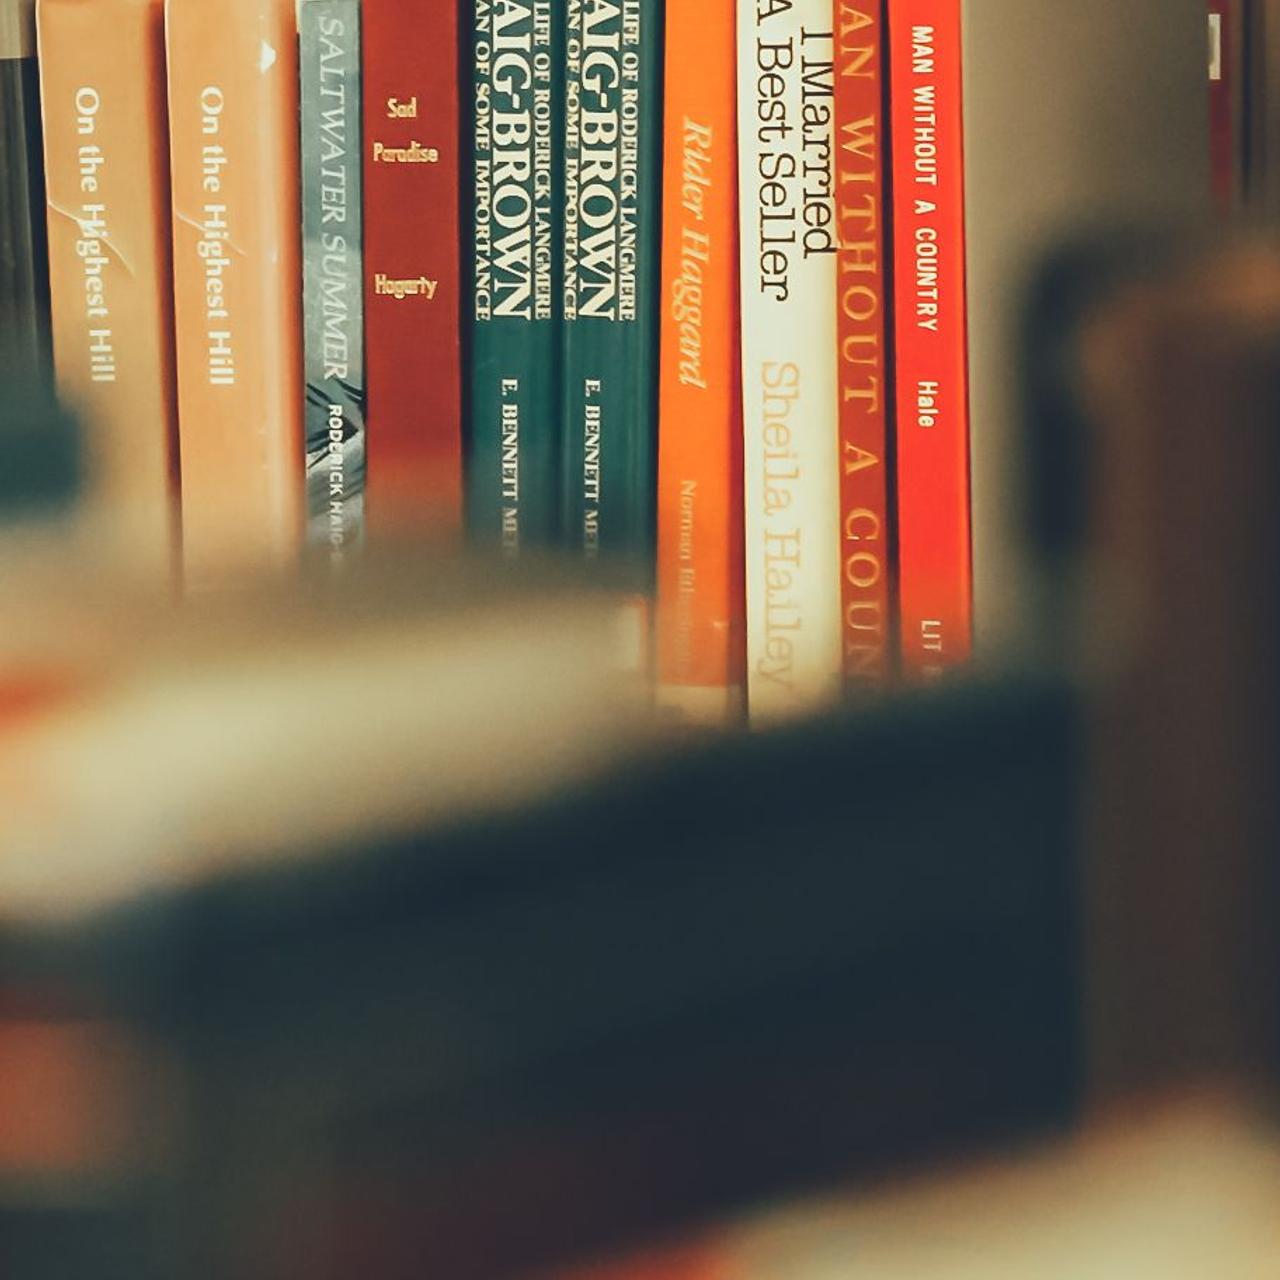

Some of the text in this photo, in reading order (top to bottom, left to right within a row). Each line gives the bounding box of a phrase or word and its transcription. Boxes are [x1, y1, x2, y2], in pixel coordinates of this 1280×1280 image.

[475, 42, 491, 76] OF
[534, 2, 550, 46] LIFE
[534, 52, 551, 82] OF
[567, 38, 581, 75] OF
[621, 52, 640, 83] OF
[623, 1, 641, 45] LIFE
[387, 96, 417, 119] Sad
[475, 82, 491, 151] SOME
[566, 80, 580, 151] SOME
[757, 37, 793, 143] Best
[373, 141, 439, 163] Paradise
[534, 88, 551, 203] RODERICK
[621, 88, 639, 203] RODERICK
[800, 26, 841, 260] I Married
[912, 25, 938, 332] MAN WITHOUT A COUNTRY
[75, 86, 116, 382] On the Highest Hill
[196, 86, 235, 385] On the Highest Hill
[318, 16, 349, 380] SALTWATER SUMMER
[475, 158, 491, 322] IMPORTANCE
[564, 158, 579, 321] IMPORTANCE
[758, 152, 796, 302] Seller
[535, 207, 551, 320] LANGMERE
[619, 206, 637, 321] LANGMERE
[672, 116, 713, 390] Rider Haggard
[841, 116, 880, 415] WITHOUT
[501, 378, 519, 396] E.
[584, 378, 601, 397] E.
[917, 380, 939, 428] Hale
[327, 403, 345, 496] RODERICK
[502, 404, 519, 502] BENNETT
[584, 404, 601, 503] BENNETT
[844, 440, 880, 477] A
[756, 361, 803, 688] Sheila Hailey
[921, 620, 942, 651] LIT
